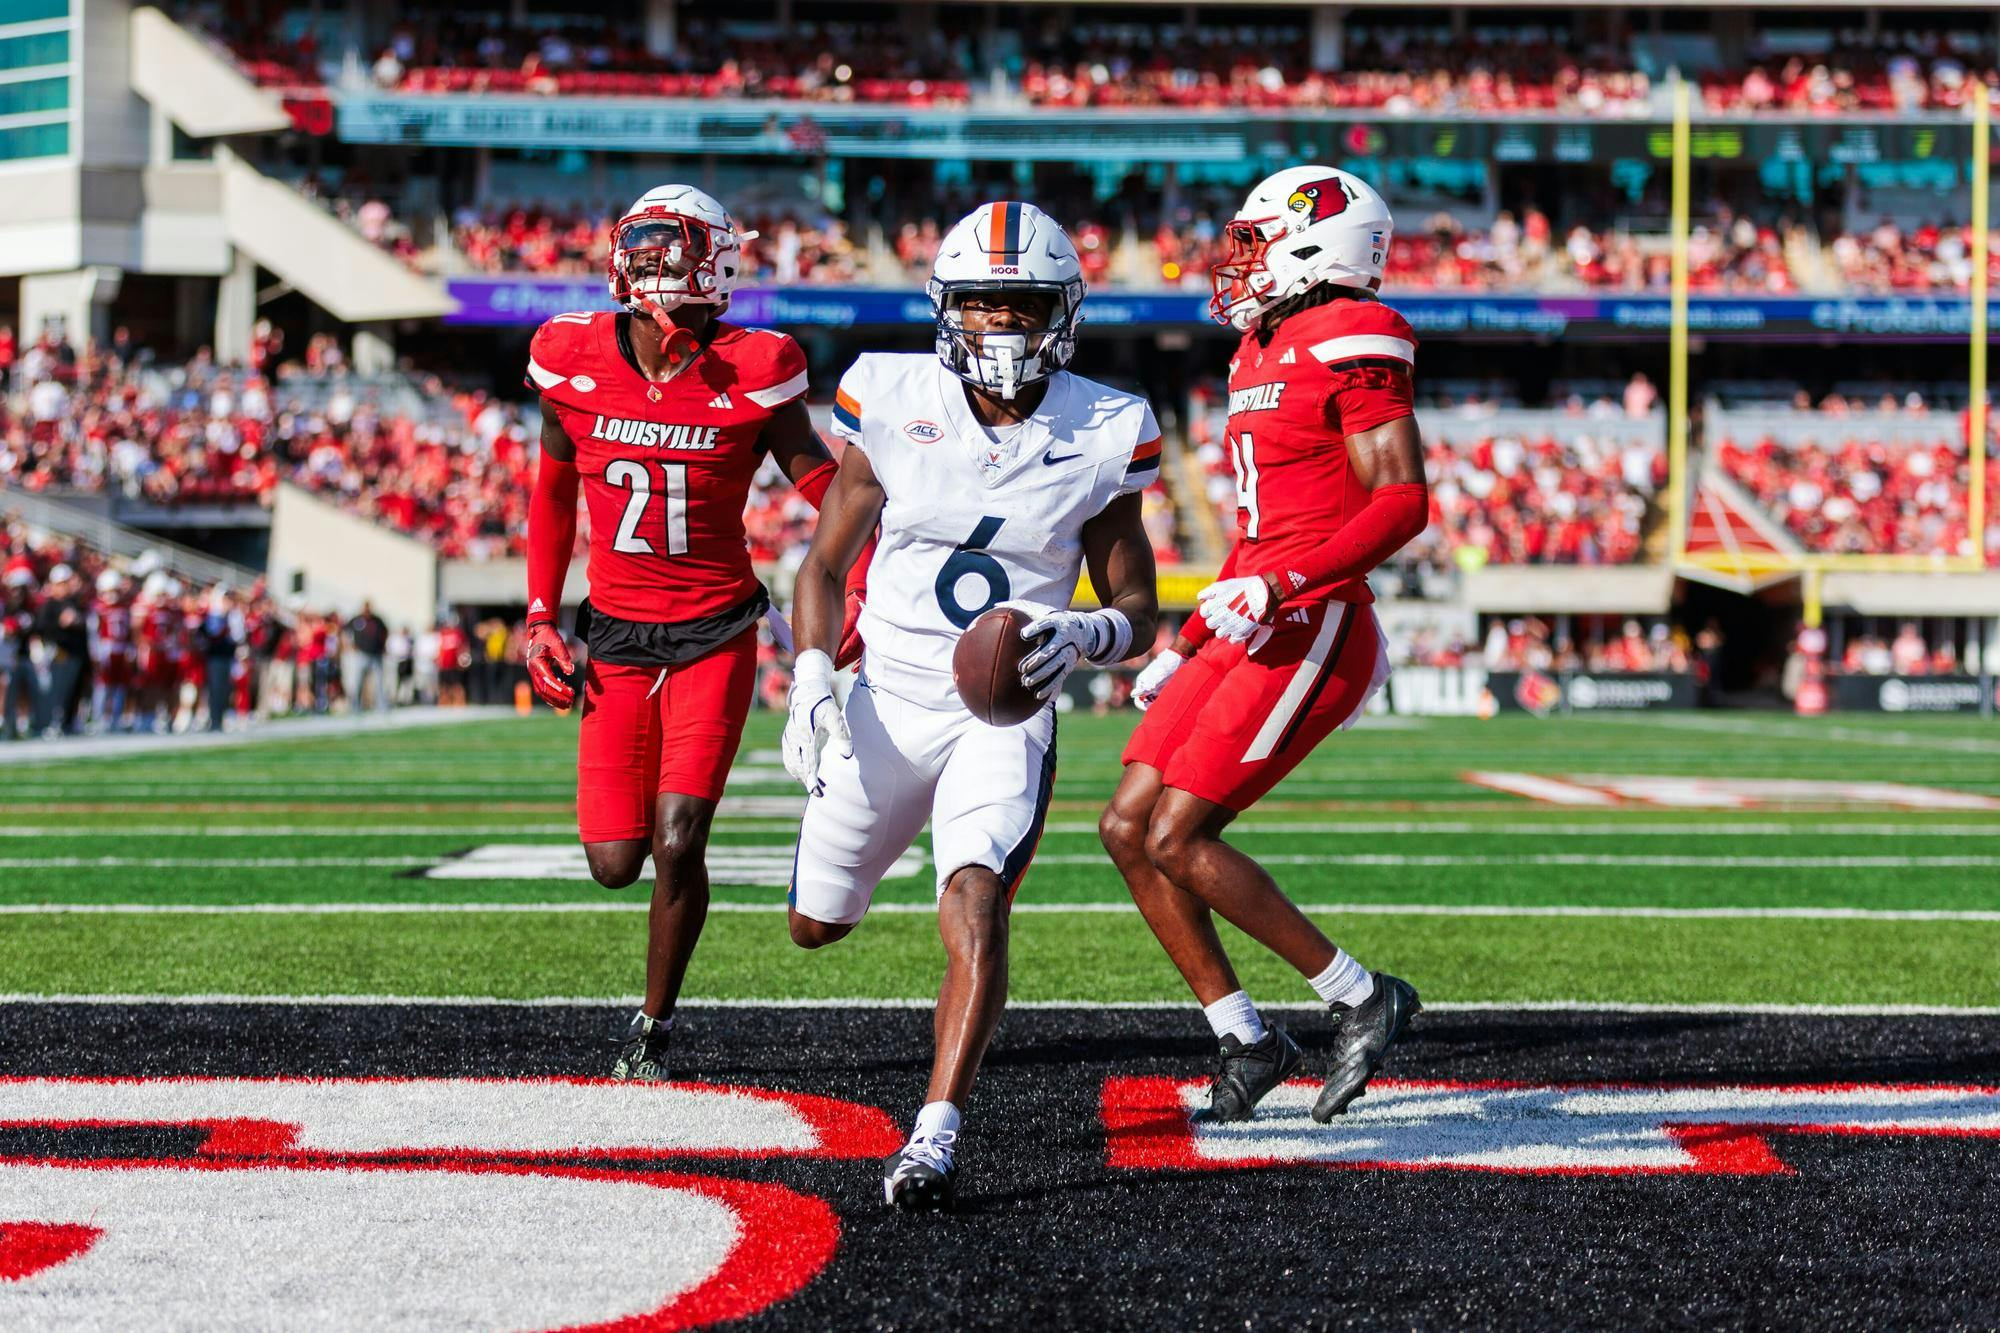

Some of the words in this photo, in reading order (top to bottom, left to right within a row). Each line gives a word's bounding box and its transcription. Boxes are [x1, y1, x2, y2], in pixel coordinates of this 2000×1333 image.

[990, 267, 1019, 275] HOOS
[590, 414, 720, 450] LOUISVILLE
[909, 424, 938, 437] ACC
[604, 458, 689, 557] 21
[935, 515, 1010, 631] 6
